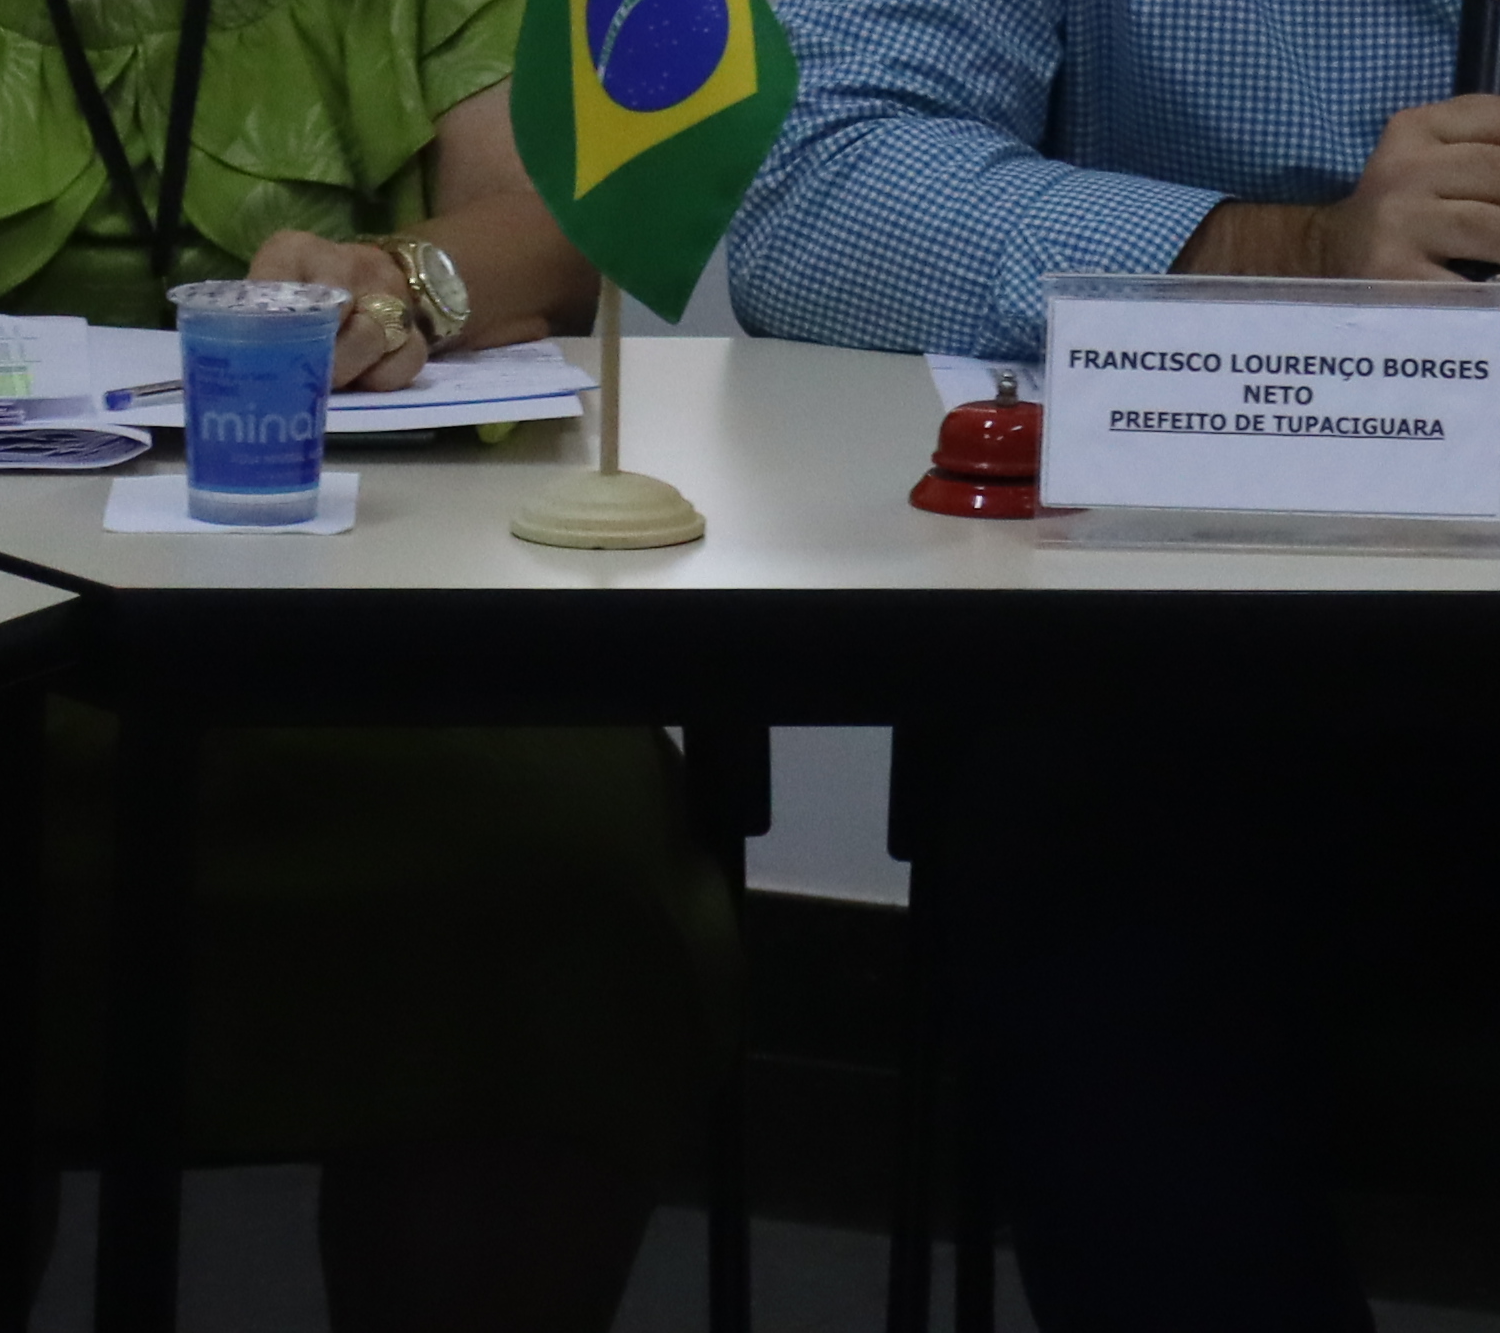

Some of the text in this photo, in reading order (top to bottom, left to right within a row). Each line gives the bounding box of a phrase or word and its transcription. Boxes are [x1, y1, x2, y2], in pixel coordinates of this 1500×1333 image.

[1069, 349, 1489, 381] FRANCISCO LOURENÇO BORGES
[1243, 384, 1313, 406] NETO
[1110, 410, 1445, 437] PREFEITO DE TUPACIGUARA
